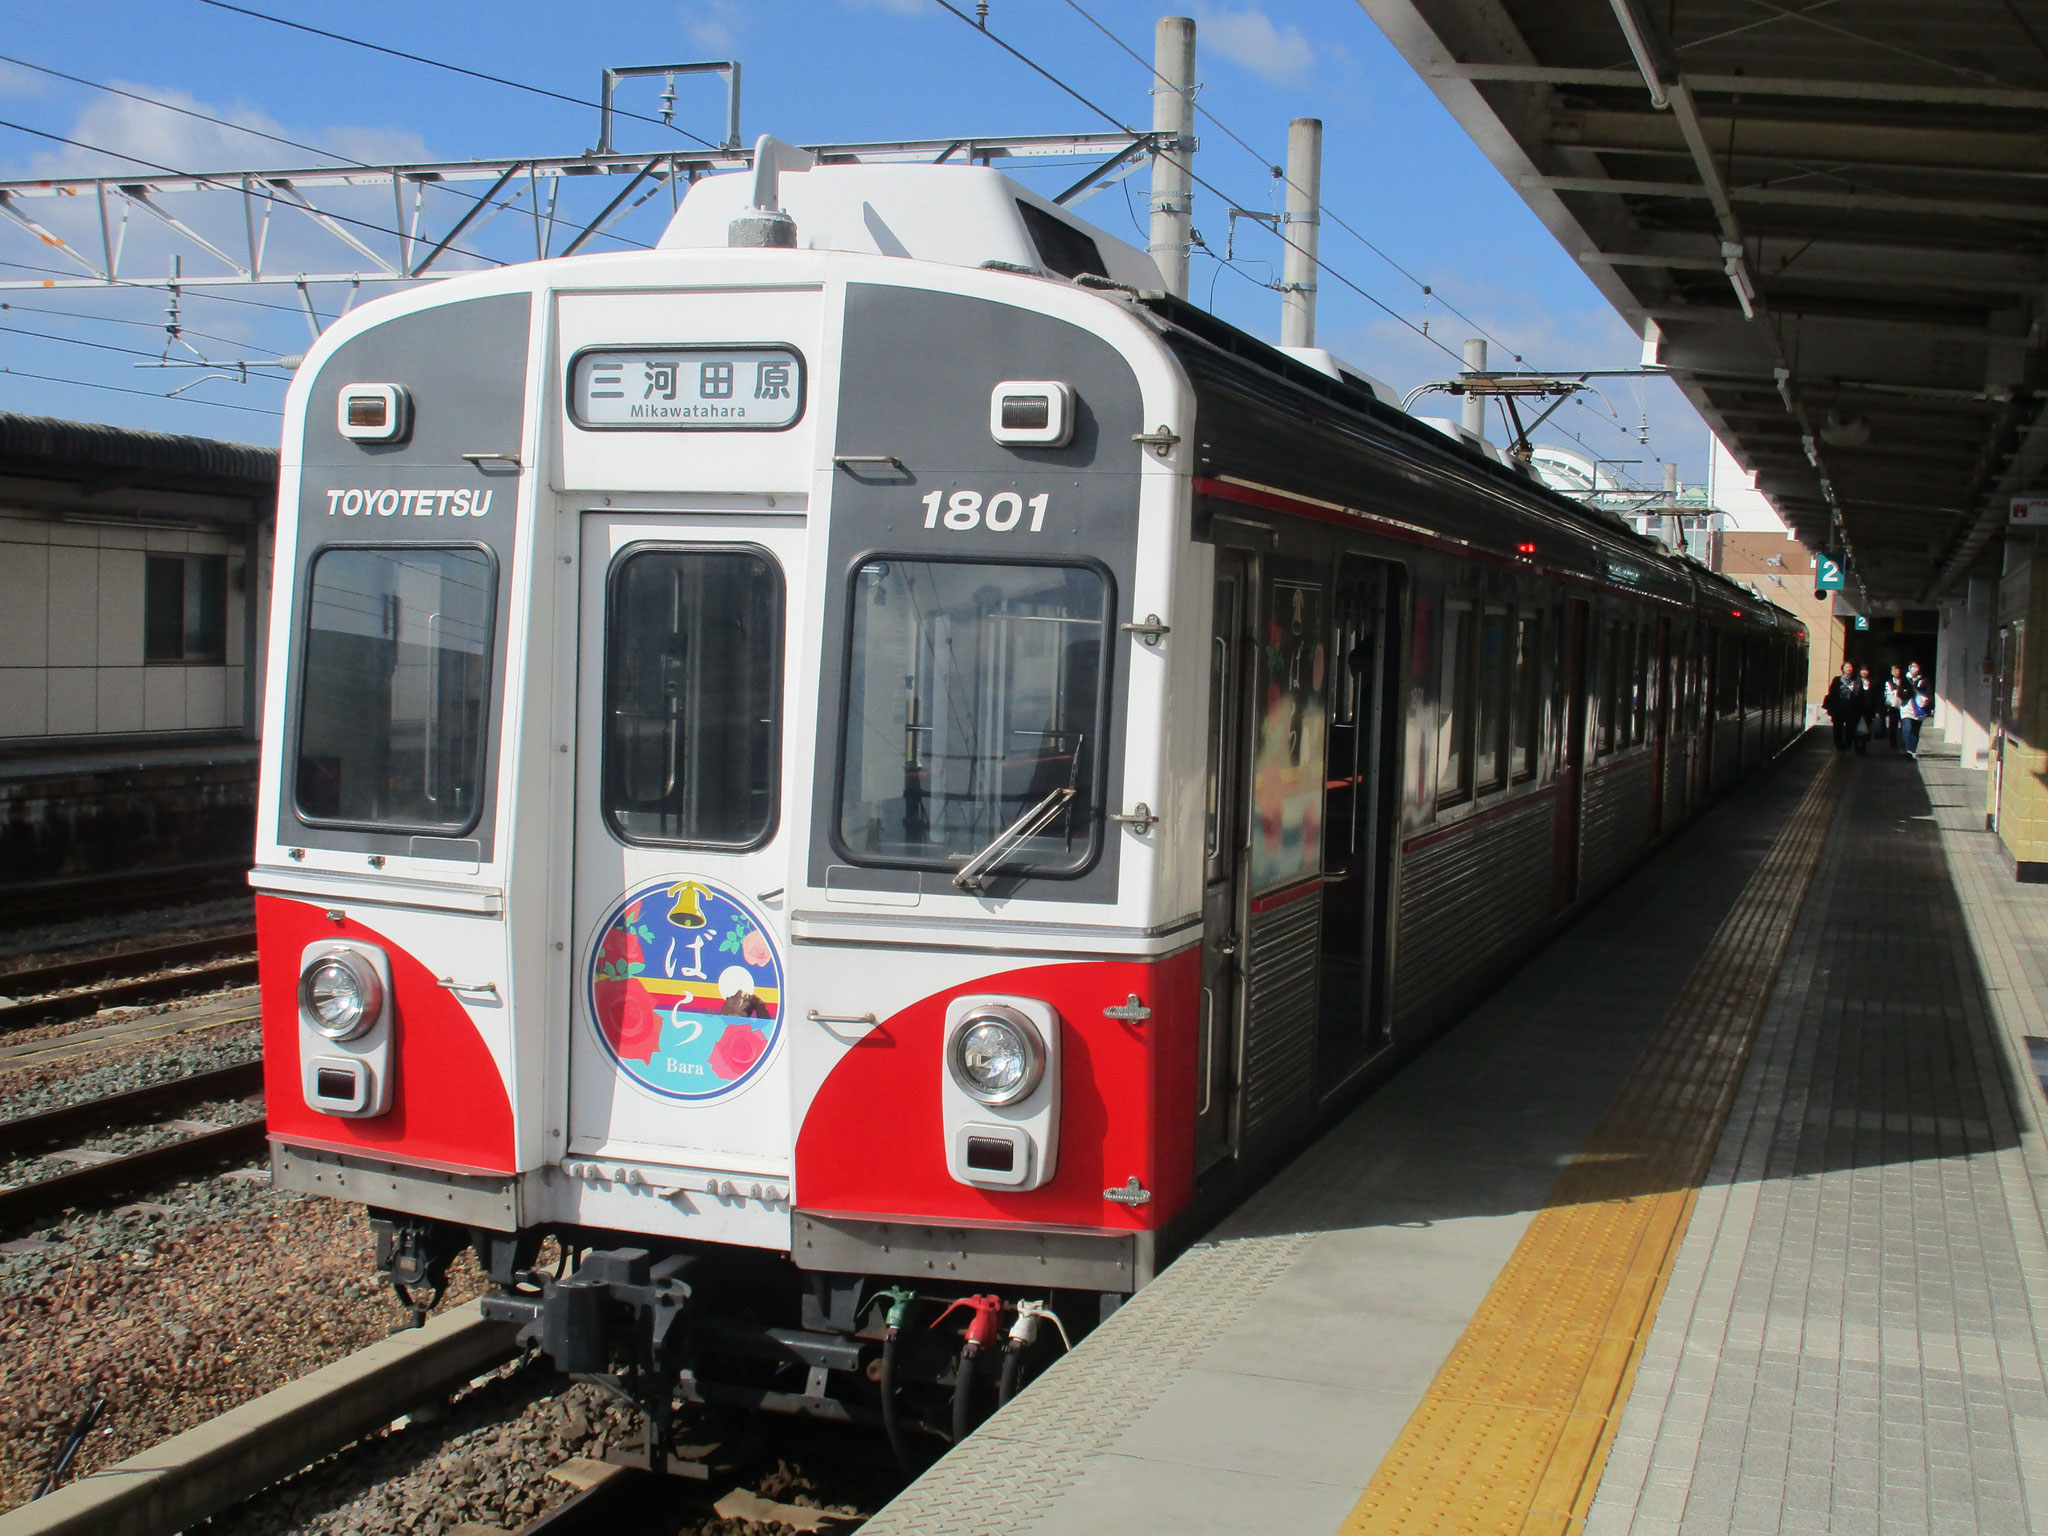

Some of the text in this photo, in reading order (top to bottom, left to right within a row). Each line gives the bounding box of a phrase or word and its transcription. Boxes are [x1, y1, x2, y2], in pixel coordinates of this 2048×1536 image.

[590, 360, 792, 401] 三河田原
[630, 403, 746, 418] Mikawatahara
[326, 488, 493, 517] TOYOTETSU
[922, 490, 1049, 532] 1801
[1822, 560, 1840, 582] 2
[1858, 616, 1867, 627] 2
[664, 928, 718, 1048] ばら
[666, 1057, 705, 1076] Bara
